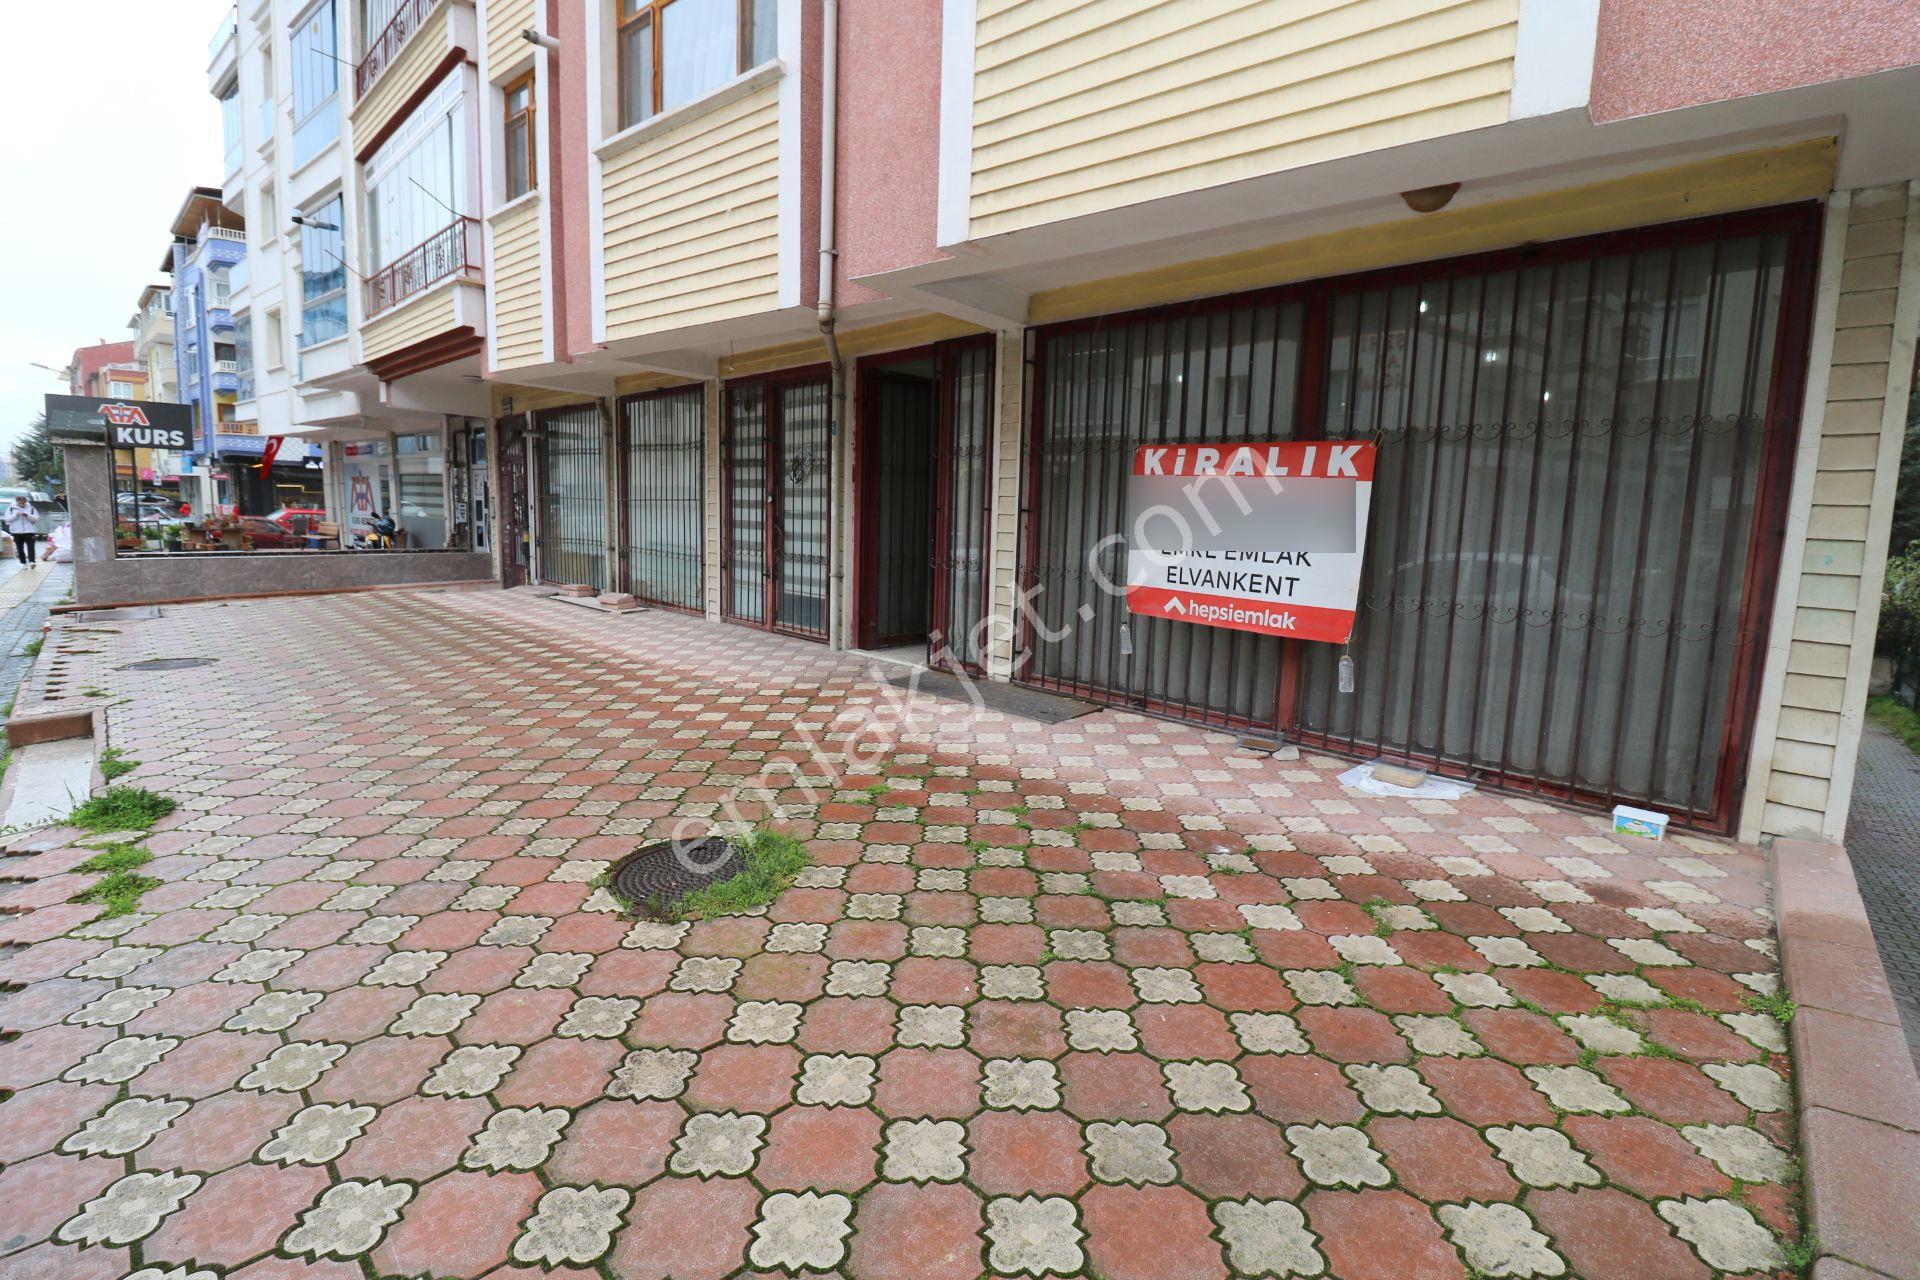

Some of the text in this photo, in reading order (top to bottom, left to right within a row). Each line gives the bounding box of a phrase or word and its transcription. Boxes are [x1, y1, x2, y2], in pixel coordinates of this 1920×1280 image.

[117, 427, 185, 446] KURS
[1166, 565, 1300, 596] ELVANKENT
[1189, 599, 1297, 630] hepsiemlak
